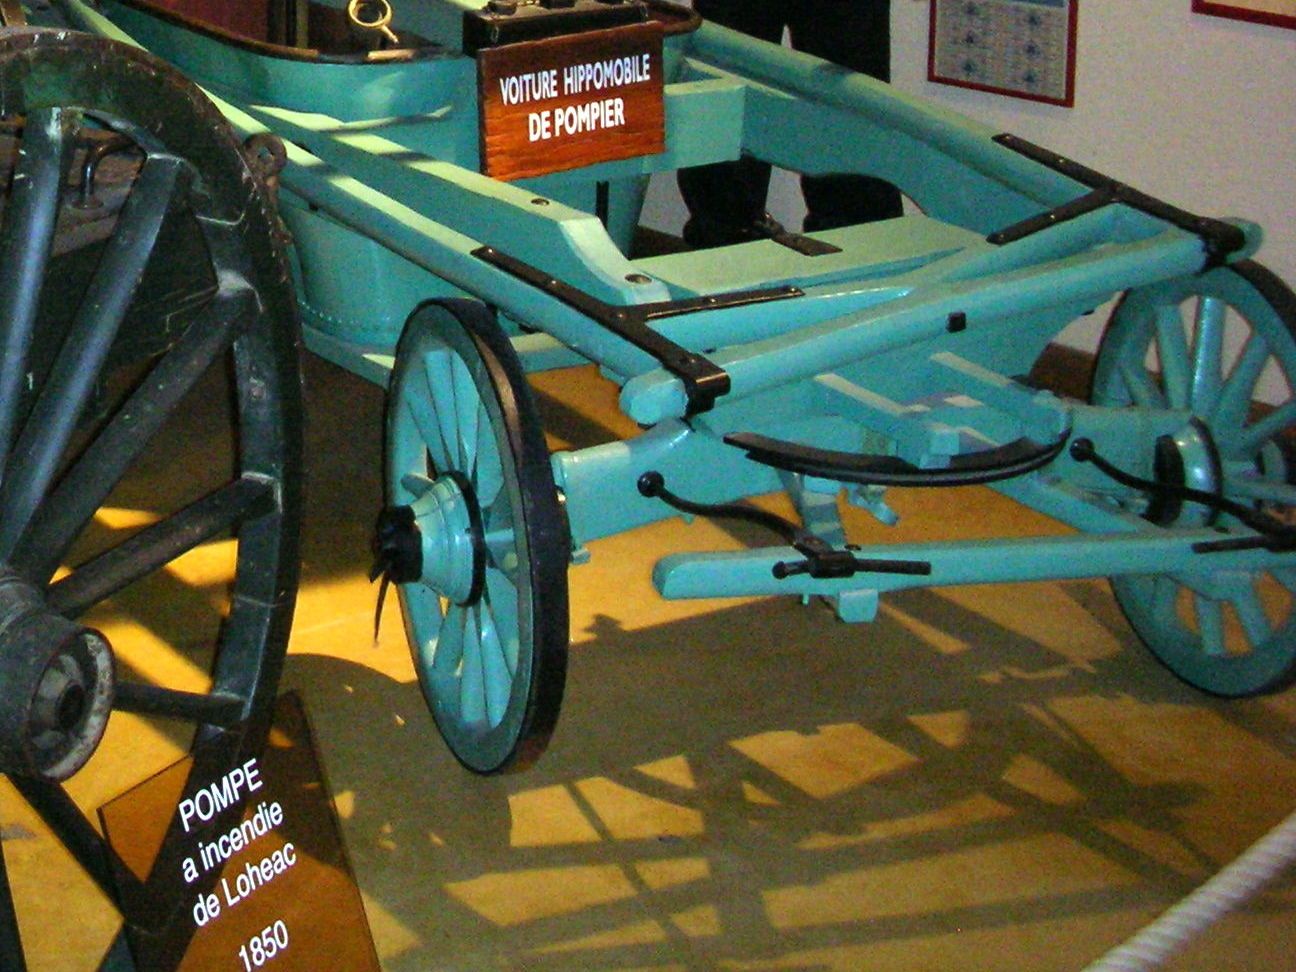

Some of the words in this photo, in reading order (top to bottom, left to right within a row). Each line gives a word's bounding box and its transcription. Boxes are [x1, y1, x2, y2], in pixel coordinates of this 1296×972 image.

[499, 69, 559, 107] VOITURE
[564, 54, 651, 95] HIPPOMOBILE
[529, 111, 552, 142] DE
[555, 98, 625, 137] POMPIER
[179, 758, 263, 832] POMPE
[198, 801, 284, 871] incendie
[192, 891, 222, 928] de
[221, 842, 298, 908] Loheac
[238, 919, 290, 972] 1850
